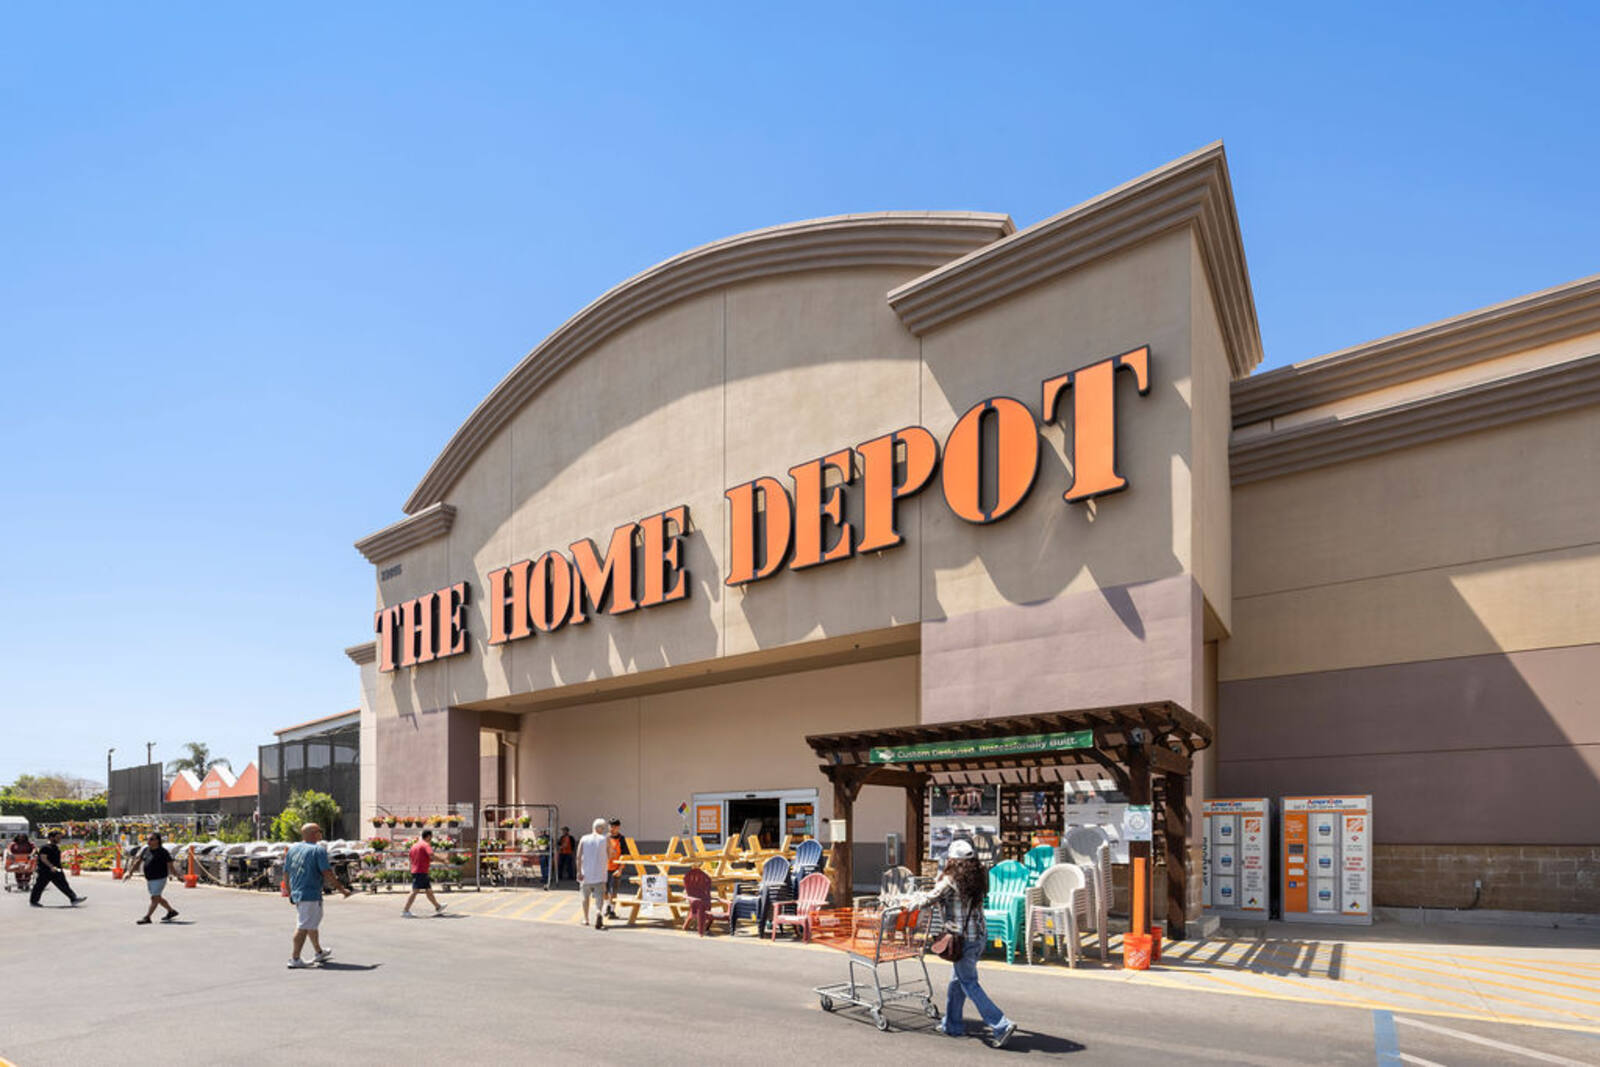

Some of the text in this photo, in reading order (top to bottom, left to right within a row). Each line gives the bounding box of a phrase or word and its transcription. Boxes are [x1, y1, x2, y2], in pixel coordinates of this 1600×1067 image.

[374, 344, 1150, 673] THE HOME DEPOT
[897, 750, 931, 759] Custom
[1049, 737, 1077, 747] Built.
